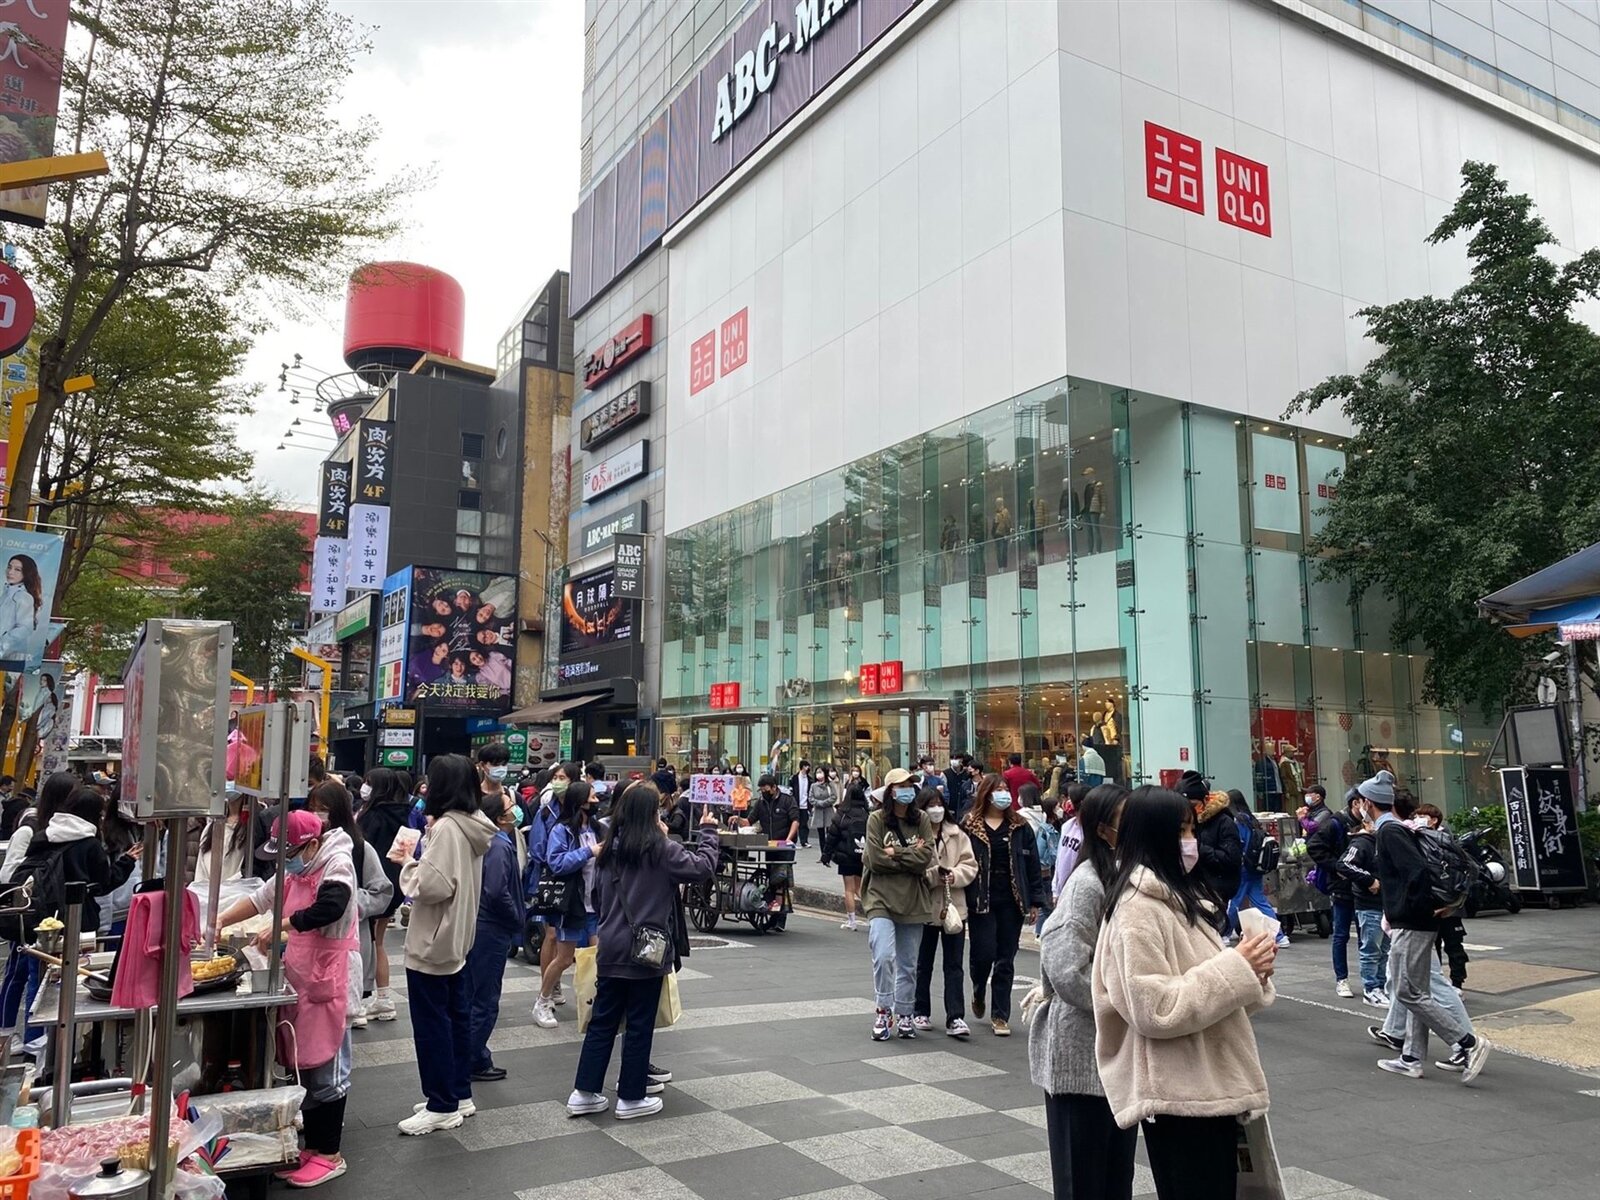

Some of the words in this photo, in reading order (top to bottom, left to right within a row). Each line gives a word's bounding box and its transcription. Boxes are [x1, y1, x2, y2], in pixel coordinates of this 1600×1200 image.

[711, 0, 856, 144] ABC-M
[1155, 135, 1196, 171] ユニ
[1154, 166, 1198, 204] クロ
[1221, 158, 1261, 196] UNI
[1223, 190, 1265, 225] QLO
[723, 318, 743, 347] UNI
[694, 338, 712, 365] ユニ
[723, 340, 744, 370] QLO
[694, 361, 712, 388] クロ
[363, 484, 386, 498] 4F
[326, 517, 346, 530] 4F
[617, 544, 641, 558] ABC
[617, 555, 642, 566] MART
[361, 574, 376, 584] 3F
[621, 581, 637, 591] 5F
[323, 599, 337, 607] 3F
[881, 665, 895, 677] UNI
[416, 682, 501, 700] 今天決定我愛你
[881, 678, 896, 690] QLO
[697, 777, 726, 795] 煎餃
[1508, 800, 1528, 870] 西門町紋身街
